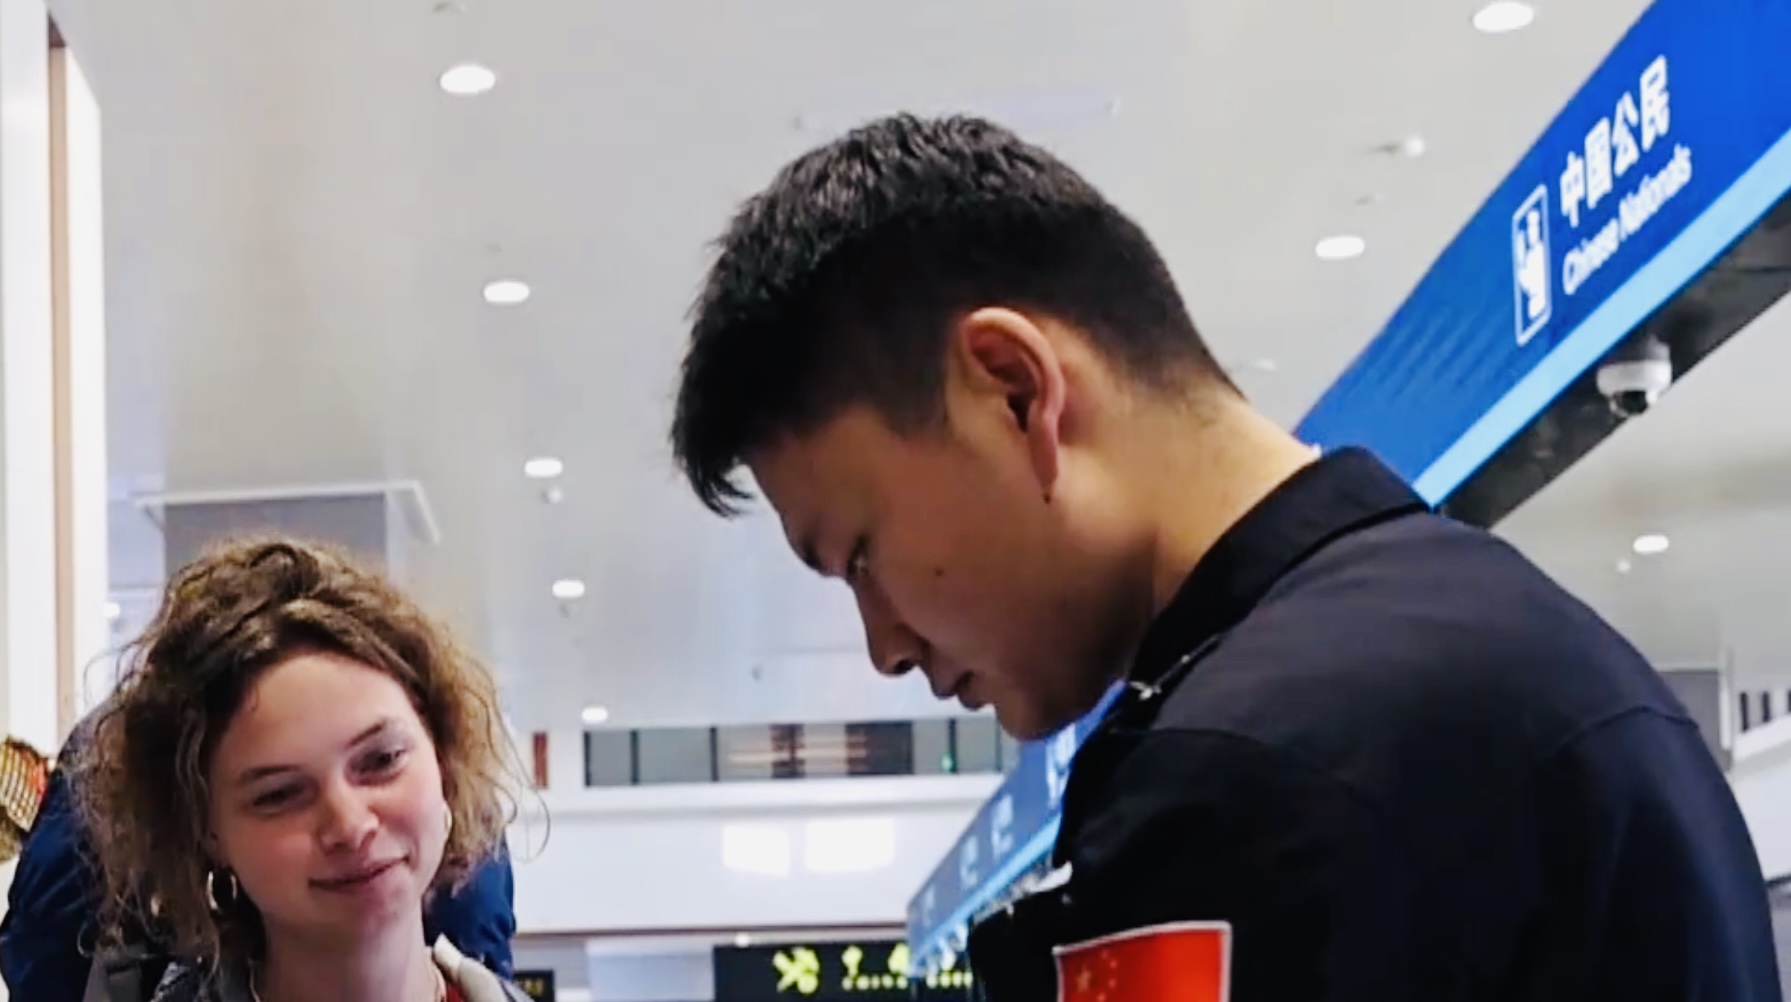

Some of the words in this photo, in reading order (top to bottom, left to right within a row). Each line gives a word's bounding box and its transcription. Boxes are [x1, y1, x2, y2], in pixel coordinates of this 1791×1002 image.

[1560, 53, 1669, 229] 中国公民
[1562, 216, 1619, 295] Chinese
[1618, 142, 1691, 242] Nationals
